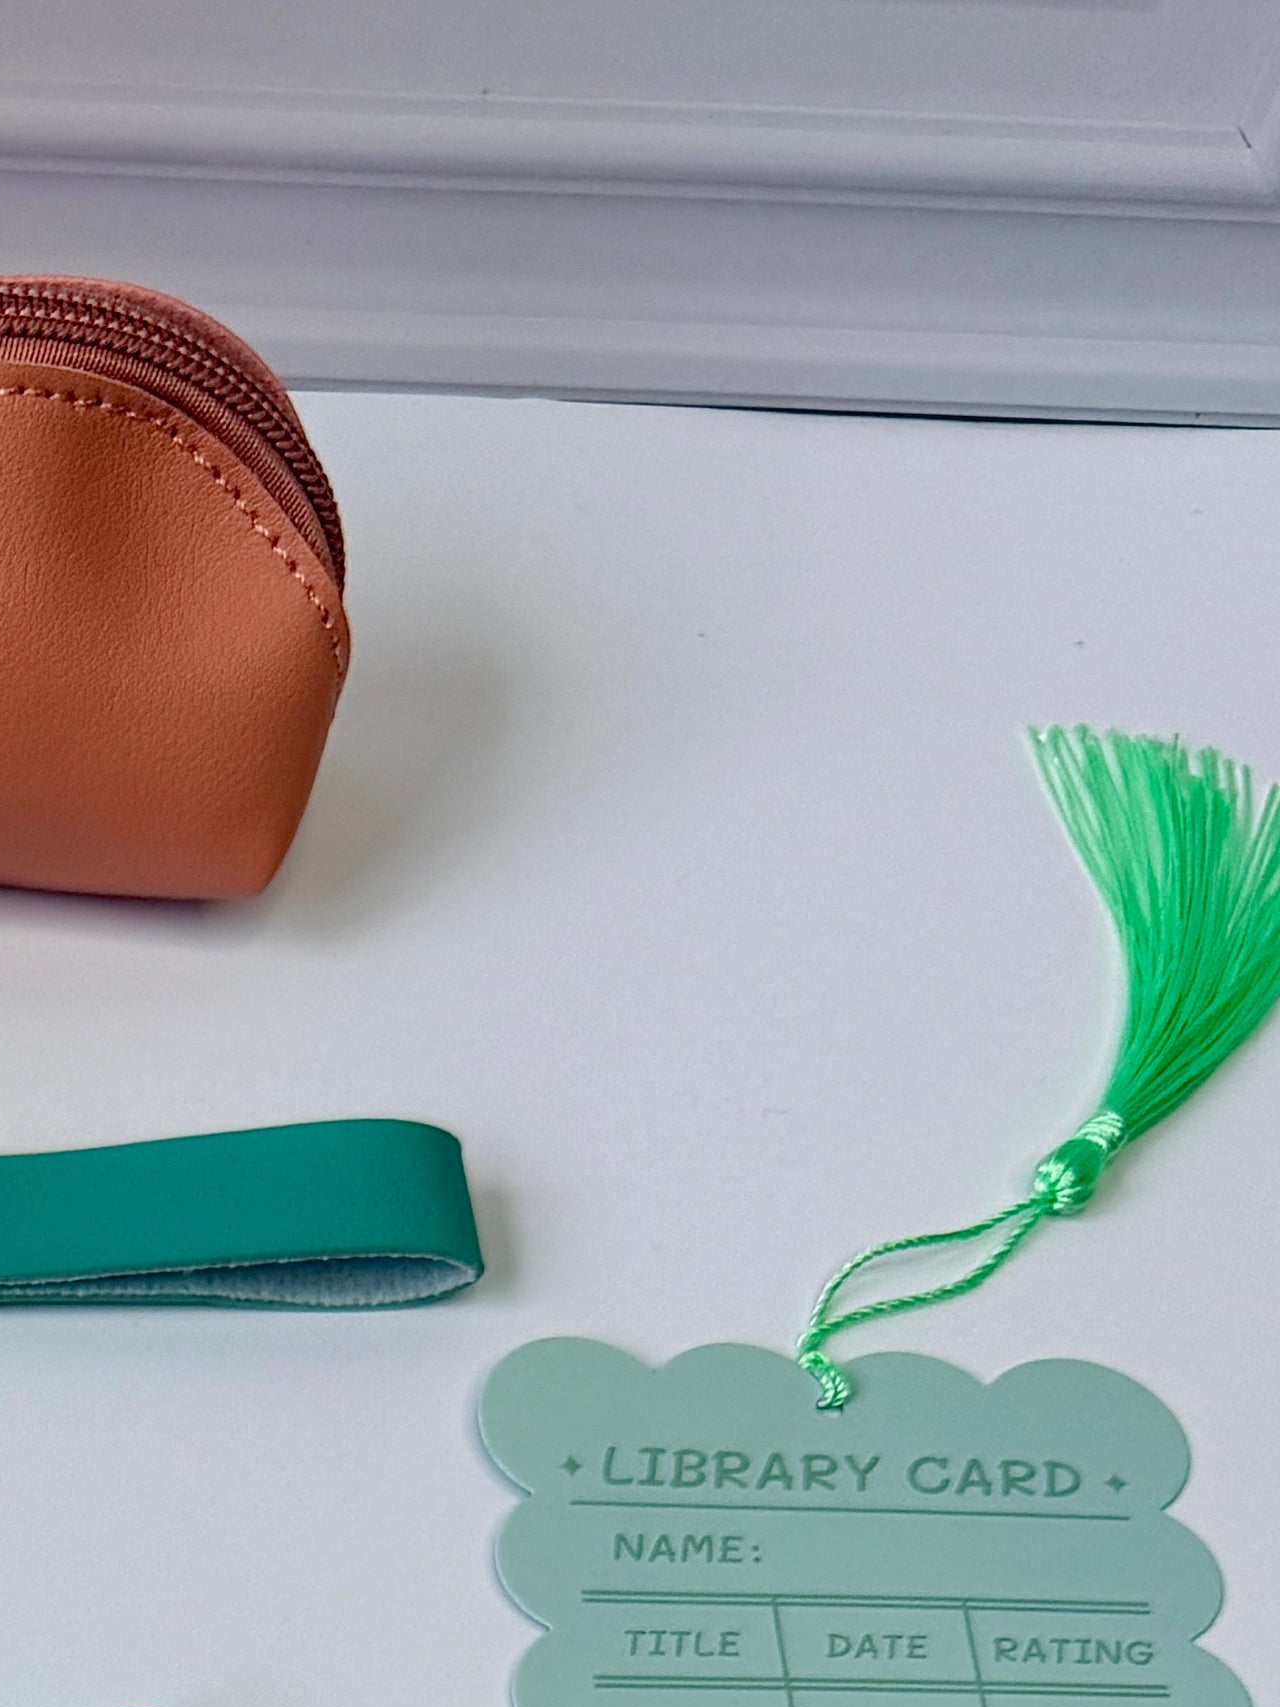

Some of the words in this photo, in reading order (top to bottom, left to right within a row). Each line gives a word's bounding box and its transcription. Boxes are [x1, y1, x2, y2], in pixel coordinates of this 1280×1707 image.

[602, 1446, 880, 1492] LIBRARY
[906, 1456, 1082, 1498] CARD
[612, 1532, 763, 1563] NAME:
[624, 1630, 741, 1657] TITLE
[826, 1633, 928, 1660] DATE
[993, 1637, 1155, 1666] RATING
